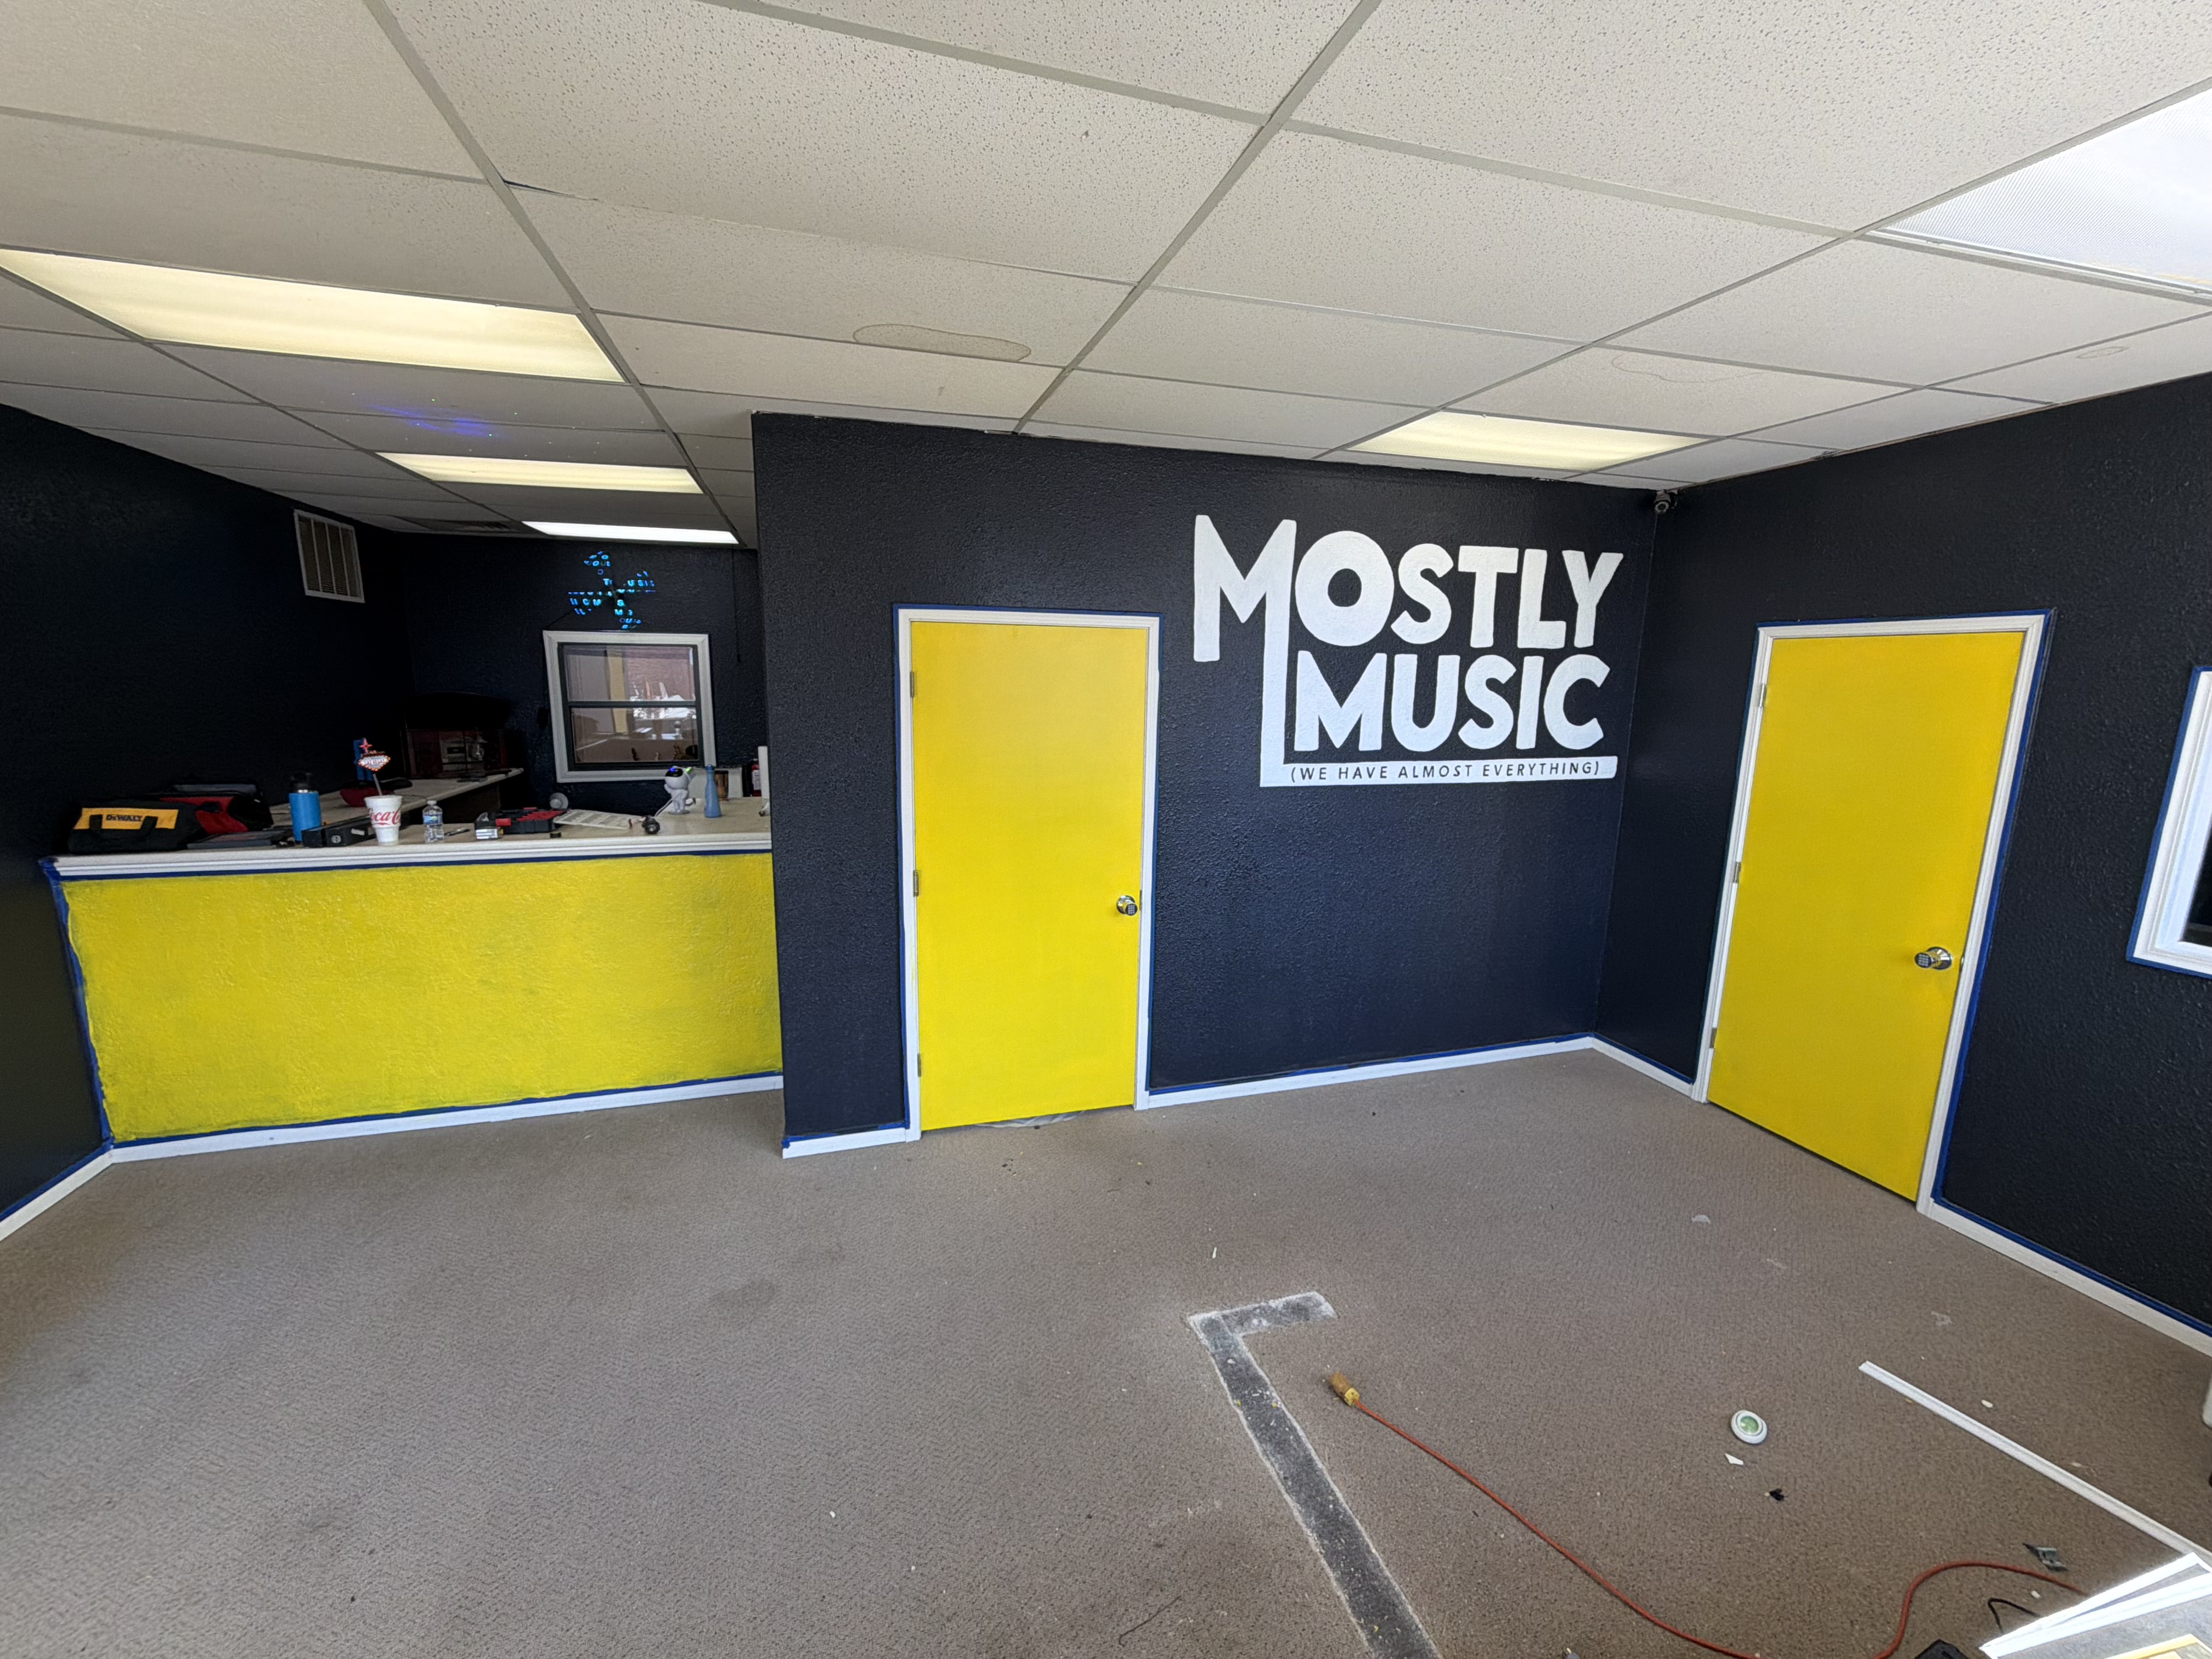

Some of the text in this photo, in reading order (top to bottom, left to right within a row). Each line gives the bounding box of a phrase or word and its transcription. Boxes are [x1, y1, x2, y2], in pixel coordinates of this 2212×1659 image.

[1194, 515, 1623, 663] MOSTLY
[1294, 650, 1610, 752] MUSIC
[1291, 761, 1599, 782] (WE HAVE ALMOST EVERYTHING)
